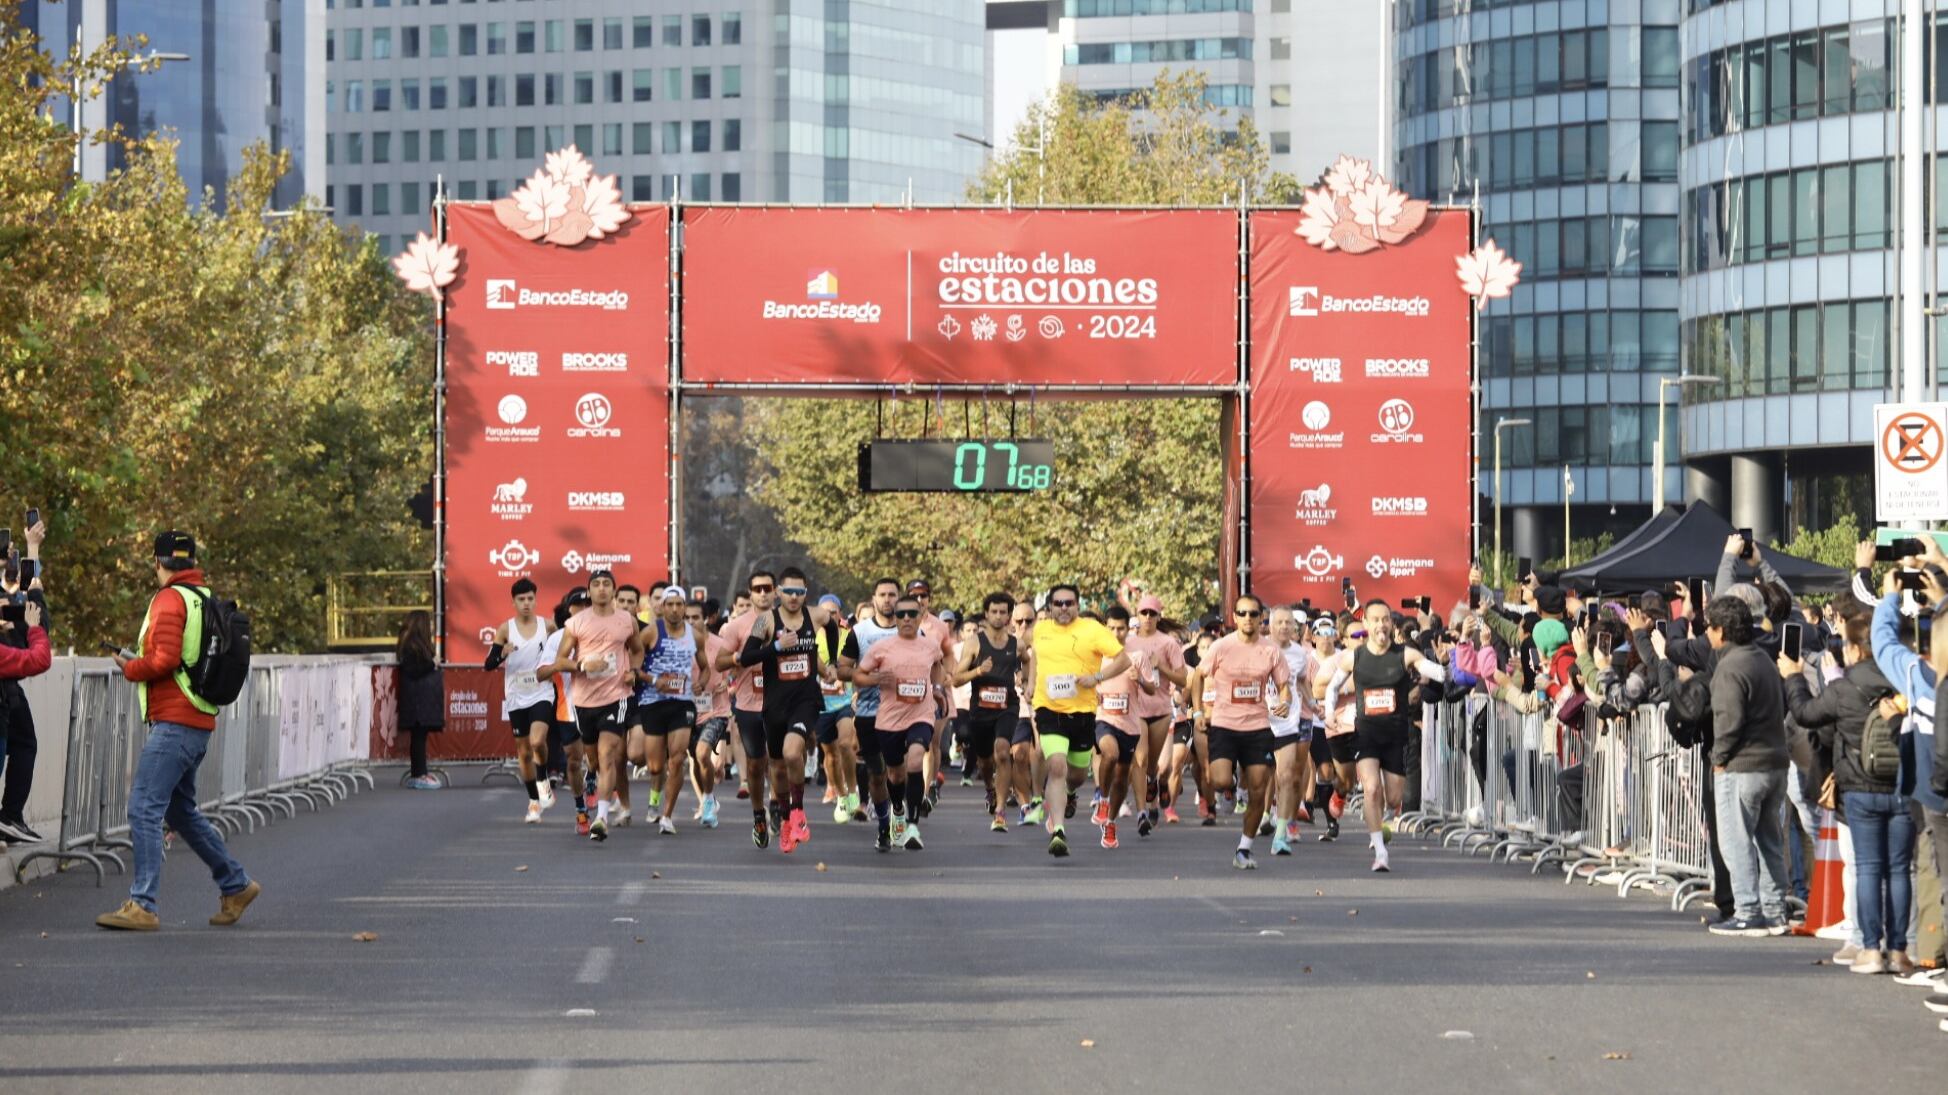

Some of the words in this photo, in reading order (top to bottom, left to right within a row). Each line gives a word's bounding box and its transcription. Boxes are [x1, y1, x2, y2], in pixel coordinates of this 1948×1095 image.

[938, 251, 1027, 274] circuito
[1031, 251, 1060, 274] de
[1063, 251, 1096, 274] las
[938, 274, 1158, 304] estaciones
[518, 288, 629, 306] BancoEstado
[1321, 295, 1430, 312] BancoEstado
[763, 300, 881, 320] BancoEstado
[1089, 315, 1157, 339] 2024
[486, 351, 538, 365] POWER
[562, 353, 627, 367] BROOKS
[1290, 358, 1341, 371] POWER
[1365, 358, 1429, 373] BROOKS
[567, 427, 621, 438] carolina
[1370, 432, 1424, 443] carolina
[953, 442, 1019, 490] 07
[1017, 464, 1050, 489] 68
[491, 503, 533, 513] MARLEY
[1296, 509, 1337, 519] MARLEY
[586, 553, 631, 563] Alemana
[1389, 557, 1434, 568] Alemana
[586, 562, 612, 574] Sport
[1389, 567, 1415, 578] Sport
[449, 699, 488, 714] estaciones
